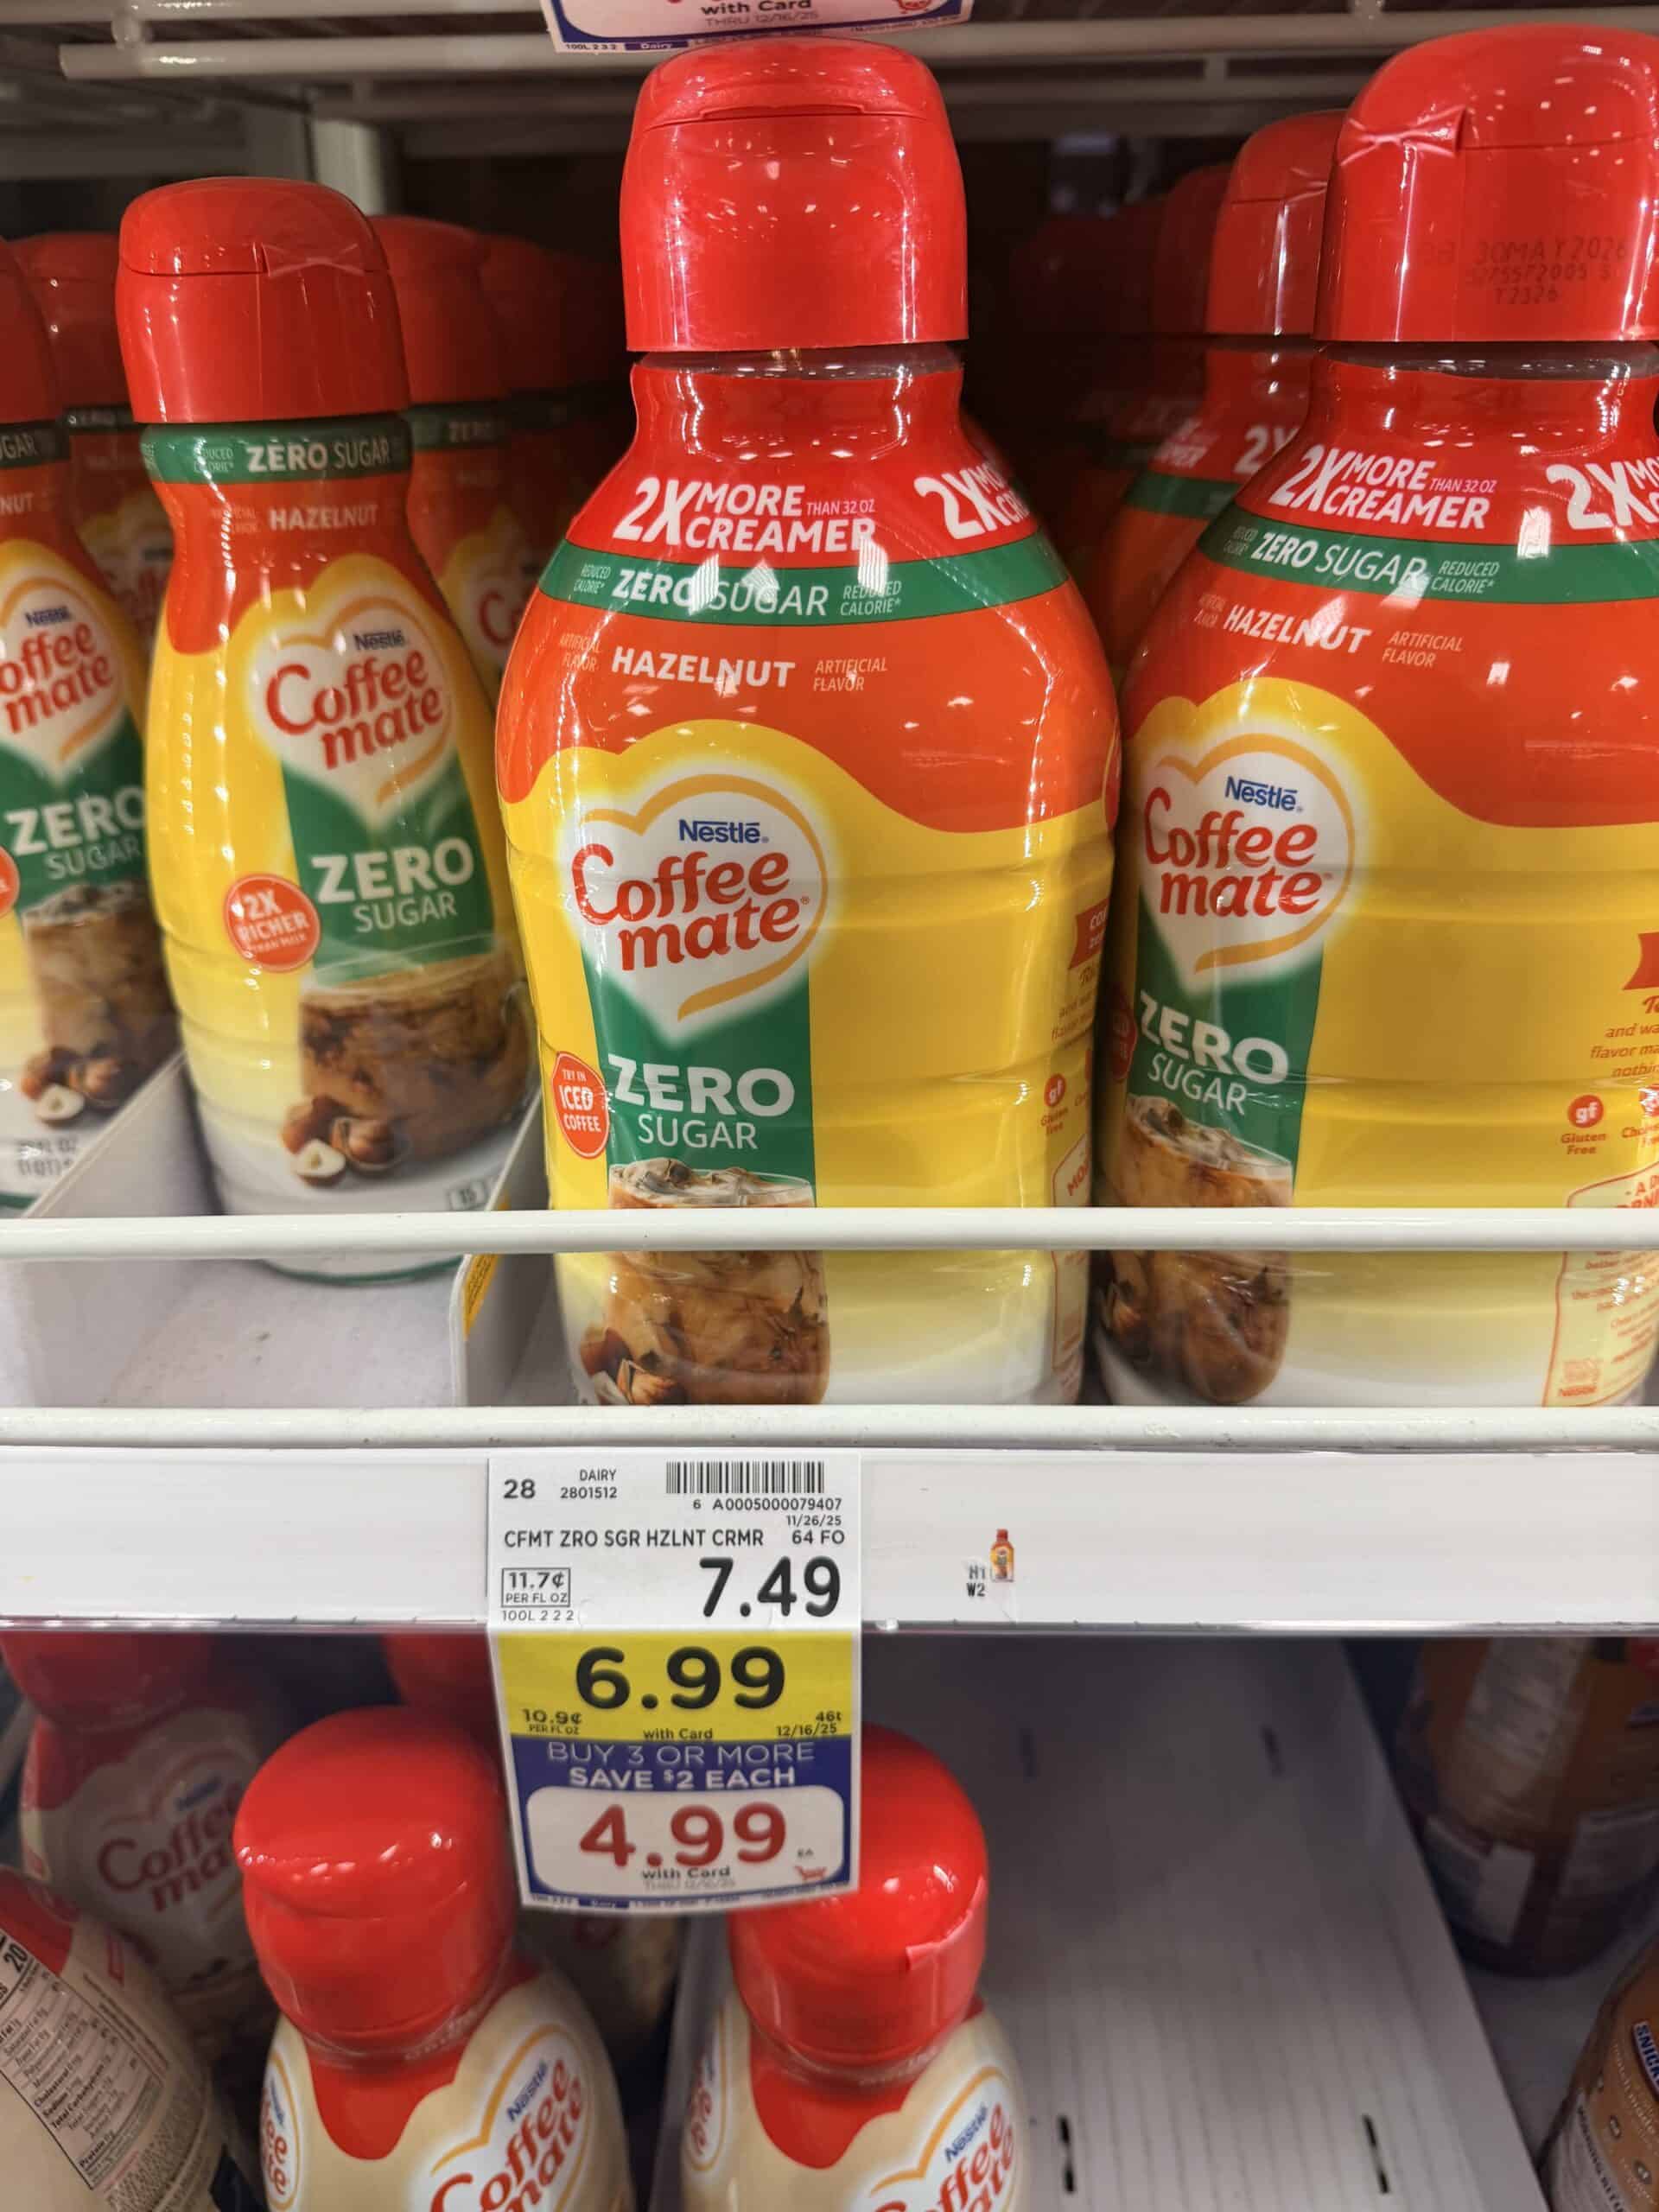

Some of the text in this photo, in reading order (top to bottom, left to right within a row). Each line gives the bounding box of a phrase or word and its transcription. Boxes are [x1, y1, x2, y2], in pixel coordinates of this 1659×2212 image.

[700, 0, 811, 15] with Card
[705, 16, 749, 27] THRU
[245, 442, 328, 473] ZERO
[334, 439, 391, 468] SUGAR
[1268, 443, 1496, 513] 2X MORE THAN 32 OZ
[913, 469, 1012, 539] 2X
[1323, 484, 1490, 529] CREAMER
[1547, 461, 1659, 530] 2X
[269, 504, 378, 531] HAZELNUT
[613, 476, 875, 543] 2X MORE THAN 32 OZ
[685, 518, 876, 553] CREAMER
[1251, 531, 1318, 568] ZERO
[1316, 543, 1427, 586] SUGAR
[1439, 560, 1500, 577] REDUCED
[612, 569, 829, 615] ZERO SUGAR
[842, 582, 902, 600] REDUCED
[1223, 604, 1372, 654] HAZELNUT
[1389, 630, 1463, 652] ARTIFICIAL
[612, 645, 795, 688] HAZELNUT
[815, 658, 887, 674] ARTIFICIAL
[1382, 648, 1437, 668] FLAVOR
[6, 656, 112, 734] mate
[265, 648, 429, 735] Coffee
[813, 676, 866, 692] FLAVOR
[320, 687, 444, 771] mate
[4, 785, 146, 856] ZERO
[1144, 786, 1319, 870] Coffee
[45, 835, 141, 880] SUGAR
[311, 836, 474, 905] ZERO
[570, 842, 790, 926] Coffee
[1160, 867, 1323, 918] mate
[244, 889, 283, 920] 2X
[353, 892, 458, 934] SUGAR
[237, 912, 311, 945] RICHER
[618, 896, 801, 971] mate
[1140, 988, 1288, 1085] ZERO
[1605, 1023, 1637, 1039] and
[1591, 1044, 1635, 1059] flavor
[559, 1085, 594, 1110] ICED
[608, 1053, 795, 1117] ZERO
[1147, 1052, 1249, 1116] SUGAR
[563, 1114, 601, 1132] COFFEE
[1576, 1102, 1598, 1123] gf
[637, 1114, 759, 1150] SUGAR
[1560, 1132, 1606, 1146] Gluten
[1567, 1144, 1597, 1156] Free
[503, 1478, 536, 1500] 28
[579, 1469, 617, 1482] DAIRY
[560, 1486, 618, 1500] 2801512
[692, 1498, 842, 1511] 6 A0005000079407
[786, 1515, 842, 1527] 11/26/25
[504, 1529, 845, 1548] CFMT ZRO SGR HZLNT CRMR 64 FO
[507, 1572, 566, 1590] 11.7¢
[698, 1555, 842, 1618] 7.49
[966, 1582, 985, 1597] W2
[505, 1592, 568, 1605] PER FL OZ
[501, 1610, 575, 1622] 100L 2 2 2
[576, 1646, 786, 1709] 6.99
[522, 1708, 582, 1726] 10.9¢
[529, 1724, 579, 1736] PER FL OZ
[776, 1723, 838, 1738] 12/16/25
[643, 1728, 713, 1740] with Card
[547, 1742, 815, 1764] BUY 3 OR MORE
[569, 1767, 796, 1790] SAVE $2 EACH
[578, 1801, 786, 1868] 4.99
[642, 1866, 731, 1881] with Card
[3, 1944, 29, 1974] 20
